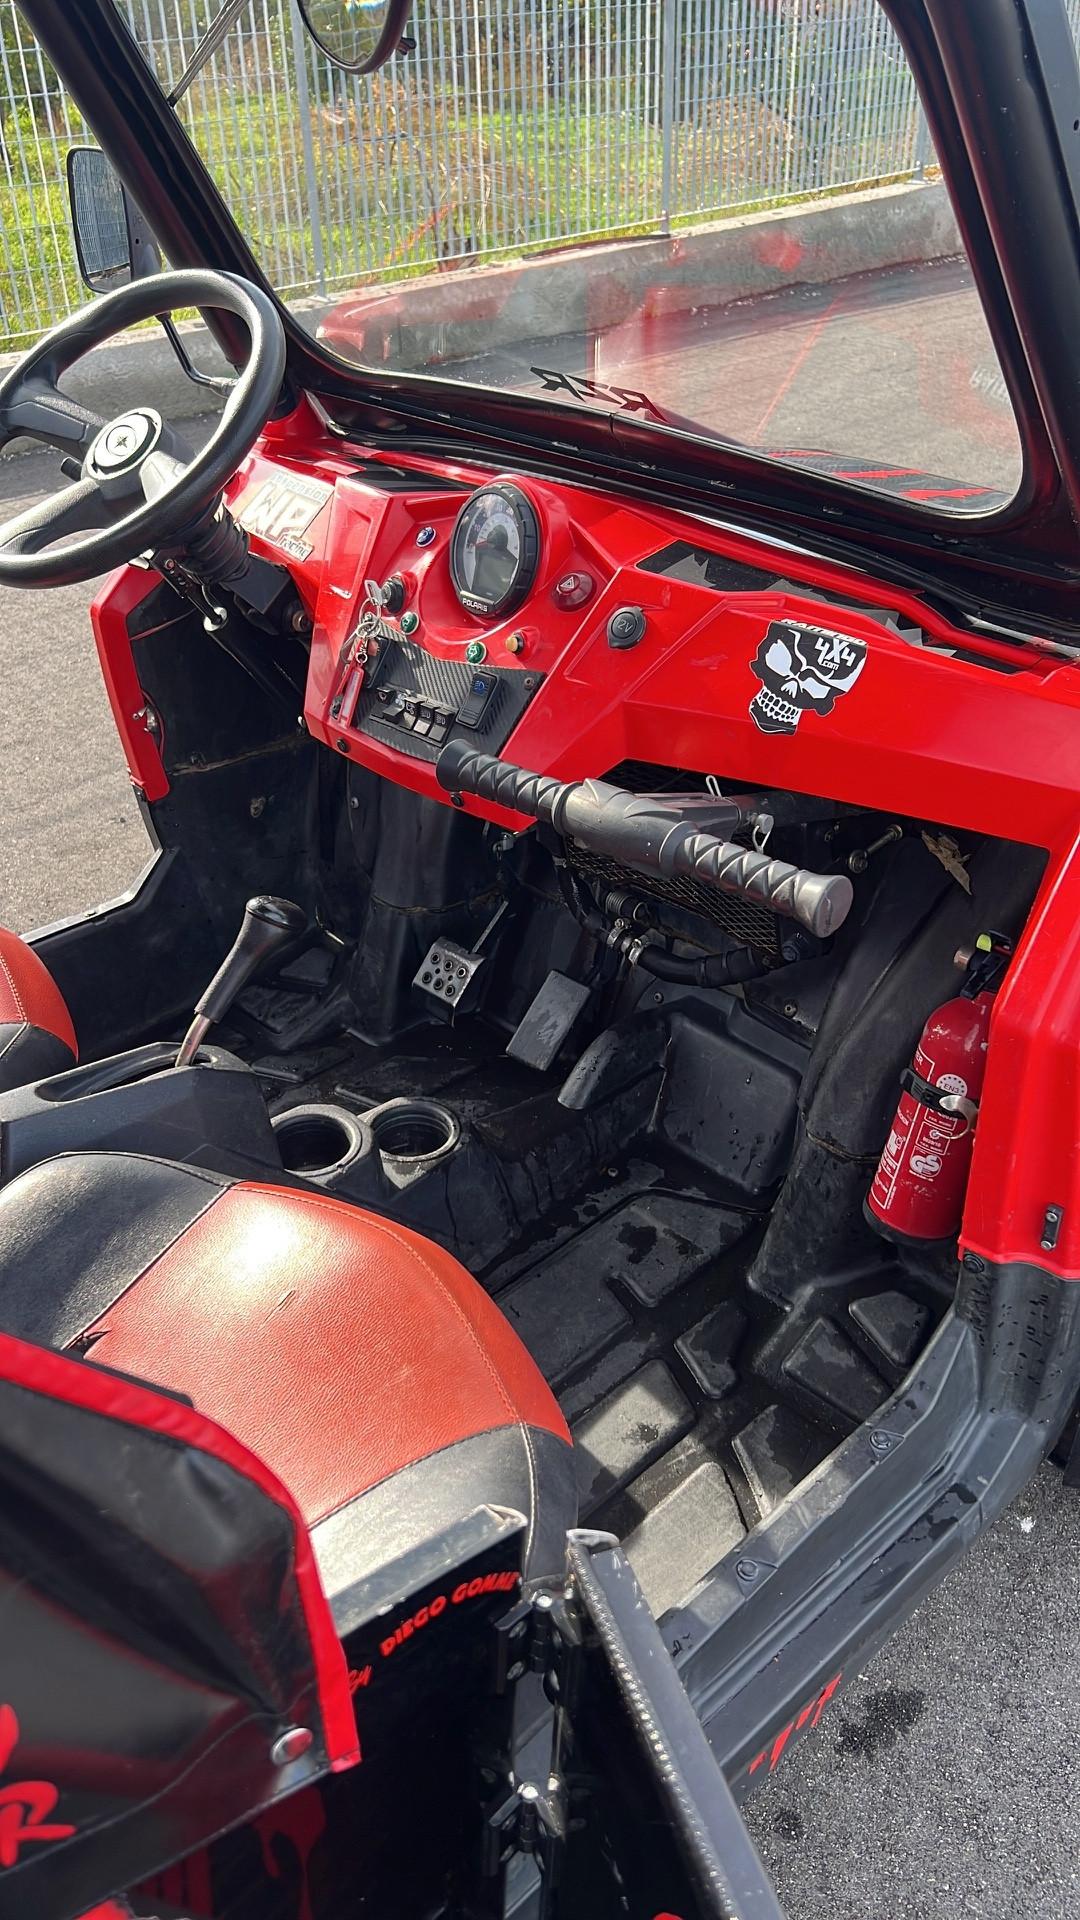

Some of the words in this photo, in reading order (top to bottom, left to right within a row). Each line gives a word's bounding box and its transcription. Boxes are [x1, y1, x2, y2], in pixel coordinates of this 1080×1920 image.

[462, 598, 488, 612] POLARIS
[943, 1082, 960, 1094] EN3
[379, 1595, 447, 1657] DIEGO
